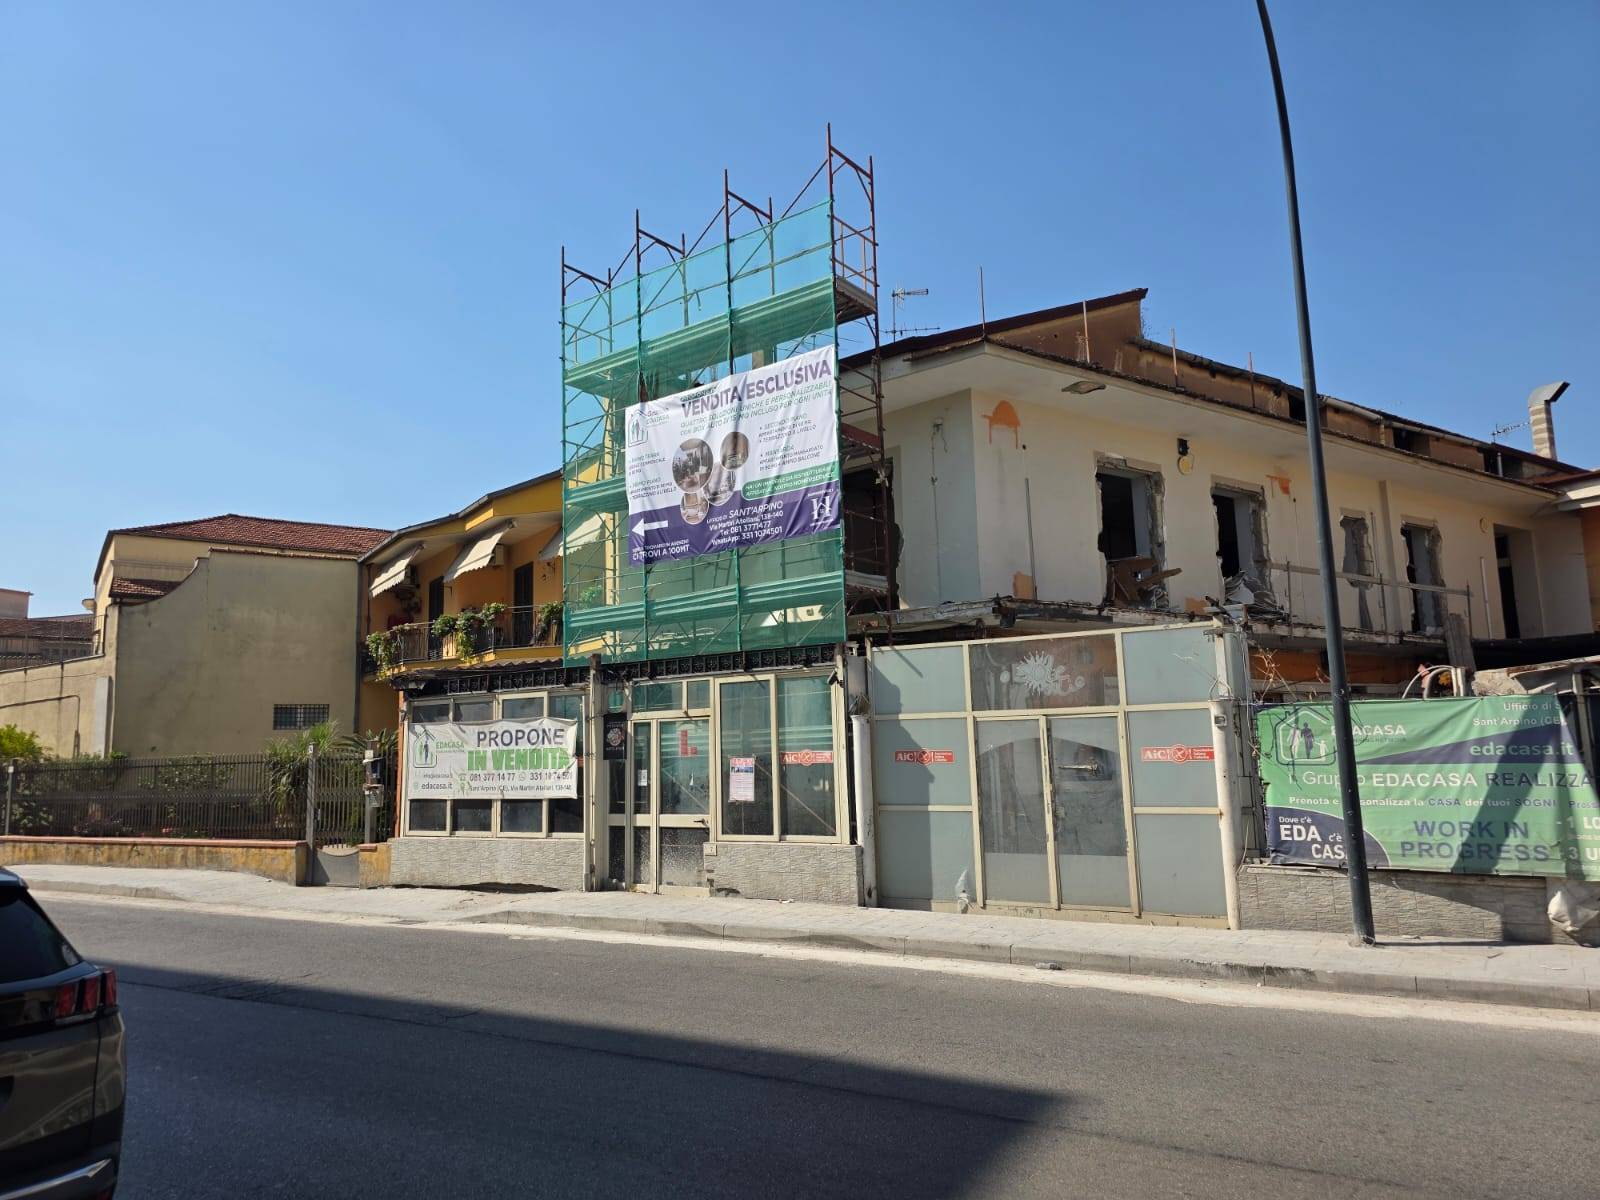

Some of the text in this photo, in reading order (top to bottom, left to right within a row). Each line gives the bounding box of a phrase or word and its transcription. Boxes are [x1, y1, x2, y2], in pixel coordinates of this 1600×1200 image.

[681, 386, 742, 417] VENDITA
[746, 360, 831, 399] ESCLUSIVA
[729, 501, 783, 519] SANT'ARPINO
[730, 525, 741, 534] 081
[743, 520, 771, 531] 3771477
[742, 531, 753, 539] 331
[754, 526, 782, 537] 1074501
[1504, 702, 1538, 711] Ufficio
[1542, 702, 1552, 710] di
[1473, 717, 1537, 727] Sant'Arpino
[477, 728, 564, 747] PROPONE
[1331, 725, 1407, 736] EACASA
[436, 741, 464, 749] EDACASA
[1470, 741, 1574, 756] edacasa.it
[468, 747, 570, 771] IN VENDITA
[1144, 750, 1167, 760] AiC
[497, 772, 506, 781] 14
[507, 772, 515, 781] 77
[530, 772, 542, 781] 331
[1302, 771, 1366, 789] Grupo
[1372, 773, 1477, 788] EDACASA
[1288, 796, 1329, 806] Prenota
[1428, 798, 1461, 807] CASA
[1465, 798, 1483, 807] dei
[1487, 799, 1510, 807] tuoi
[1514, 798, 1556, 807] SOGNI
[1278, 815, 1313, 824] Dove c'è
[1279, 824, 1343, 842] EDA c'è
[1414, 820, 1529, 839] WORK IN
[1311, 844, 1348, 860] CAS
[1400, 841, 1550, 862] PROGRESS
[1568, 847, 1578, 859] 3
